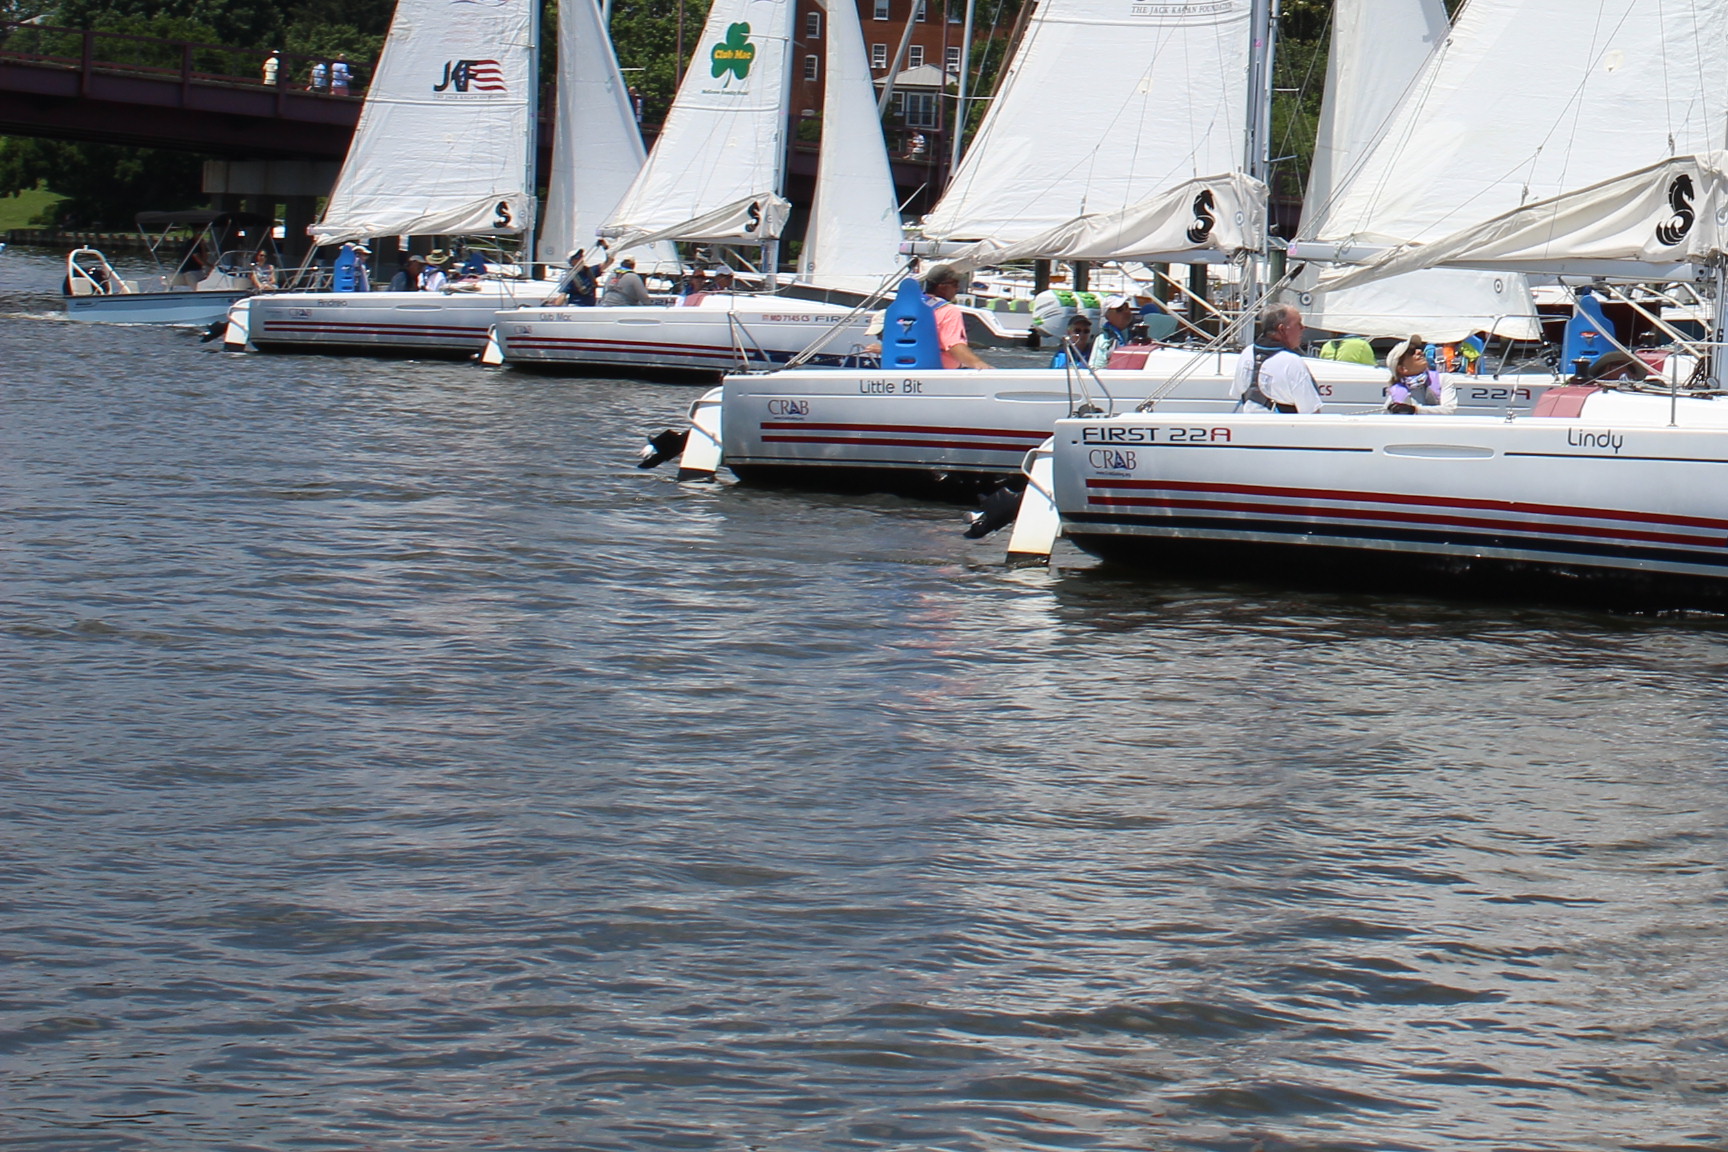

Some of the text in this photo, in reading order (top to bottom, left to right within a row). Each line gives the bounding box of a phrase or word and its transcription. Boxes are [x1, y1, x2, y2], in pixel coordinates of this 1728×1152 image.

[860, 379, 922, 394] Little Bit
[768, 399, 809, 415] CRAB
[1083, 427, 1232, 442] FIRST 22A
[1568, 427, 1623, 454] Lindy
[1089, 449, 1137, 470] CRAB
